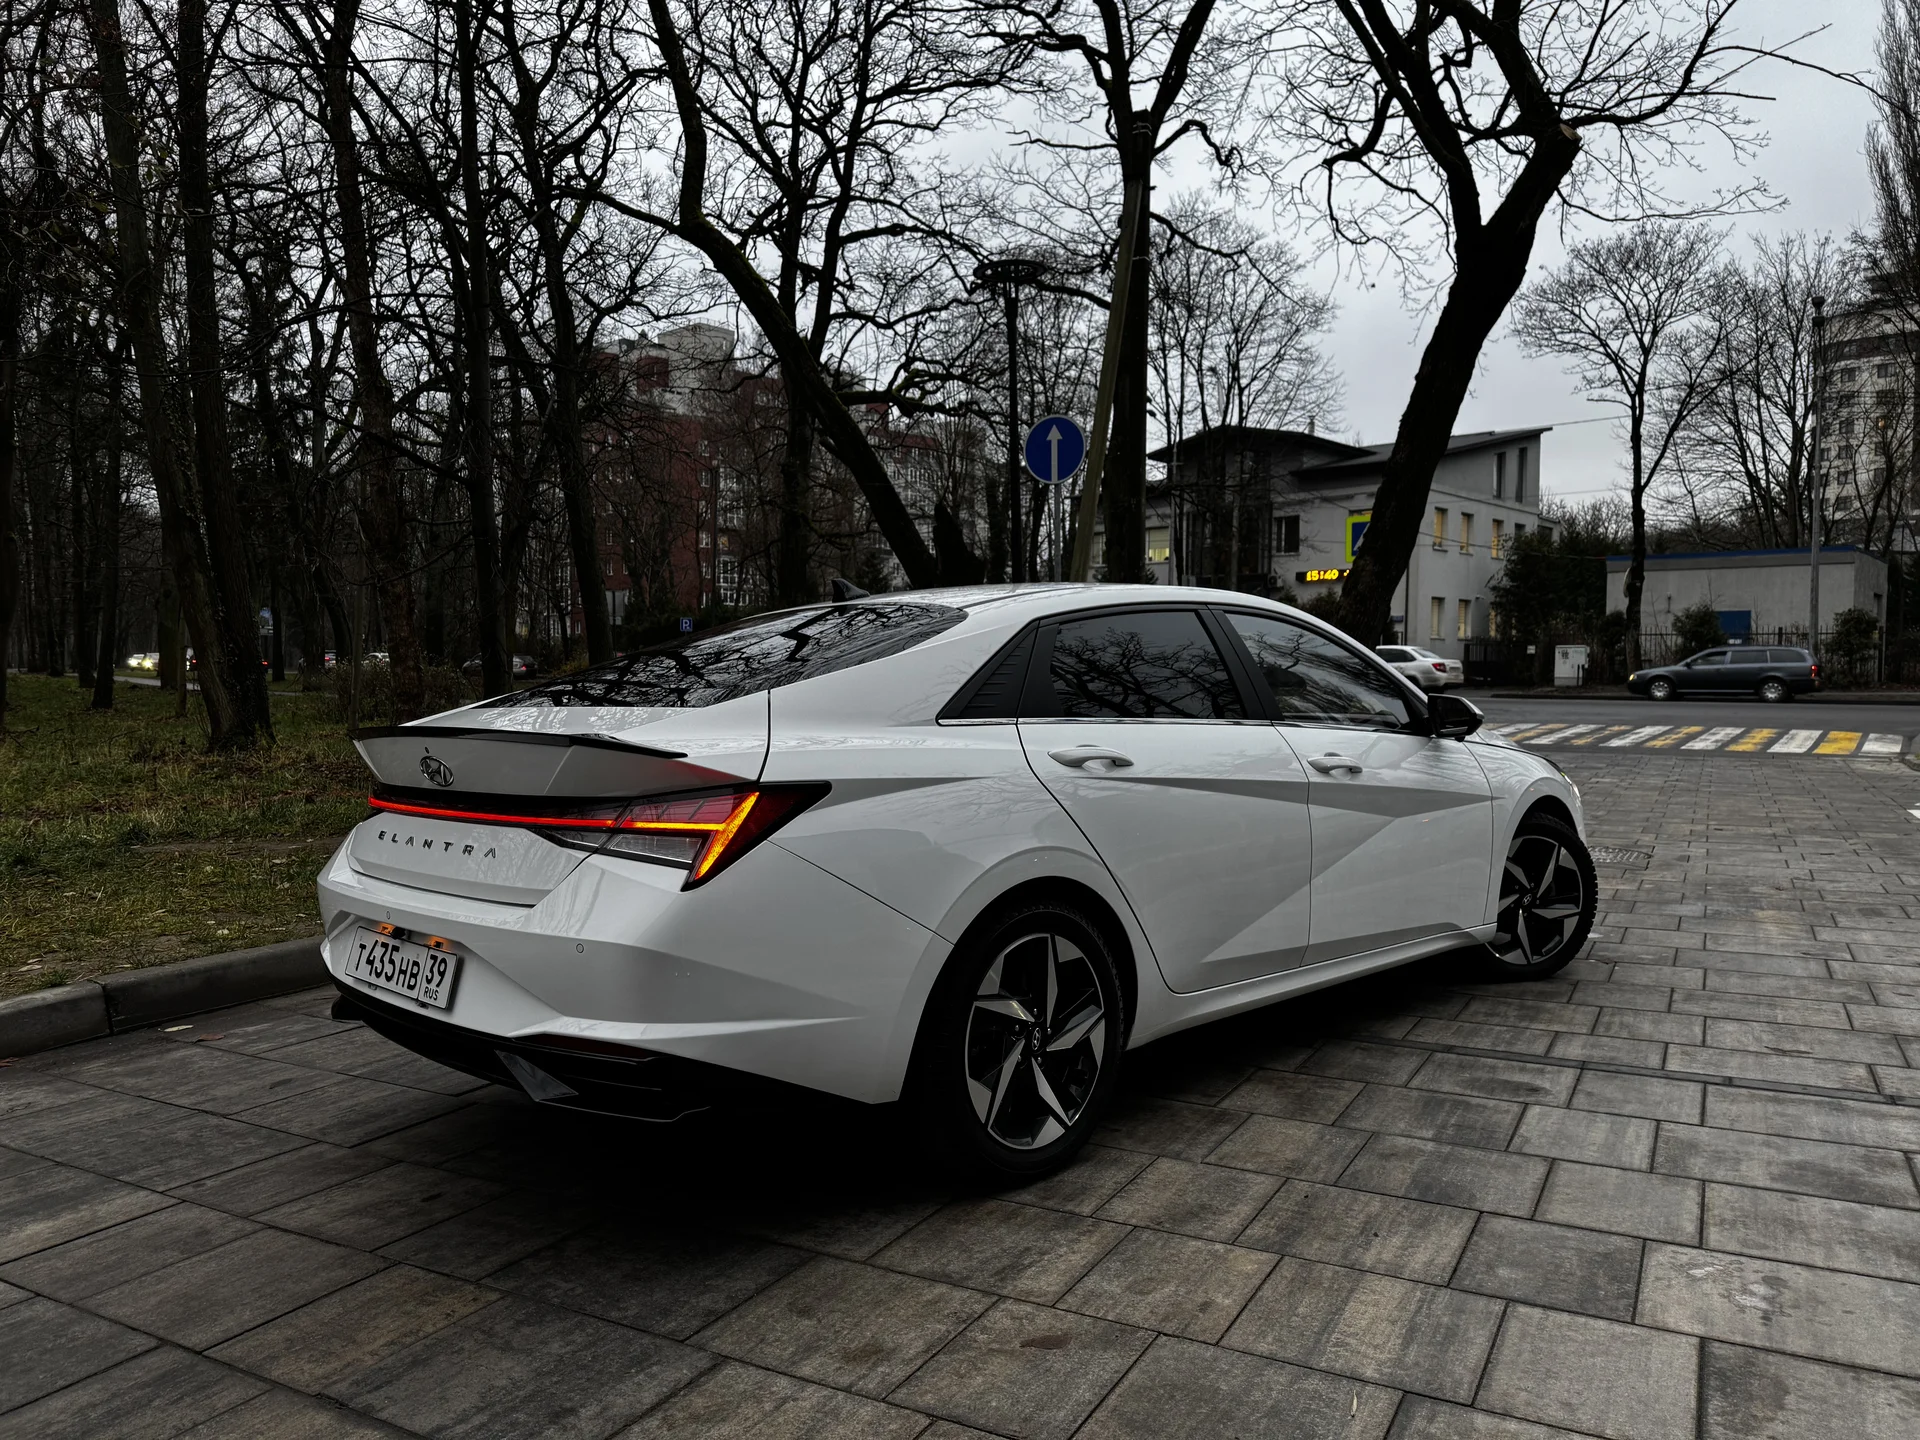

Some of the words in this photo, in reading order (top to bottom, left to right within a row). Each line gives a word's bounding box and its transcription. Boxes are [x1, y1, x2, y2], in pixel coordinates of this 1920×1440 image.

[1306, 569, 1339, 581] 15:40
[377, 829, 496, 859] ELANTRA
[355, 938, 421, 991] T435HB
[425, 953, 448, 988] 39
[423, 986, 440, 1001] RUS
